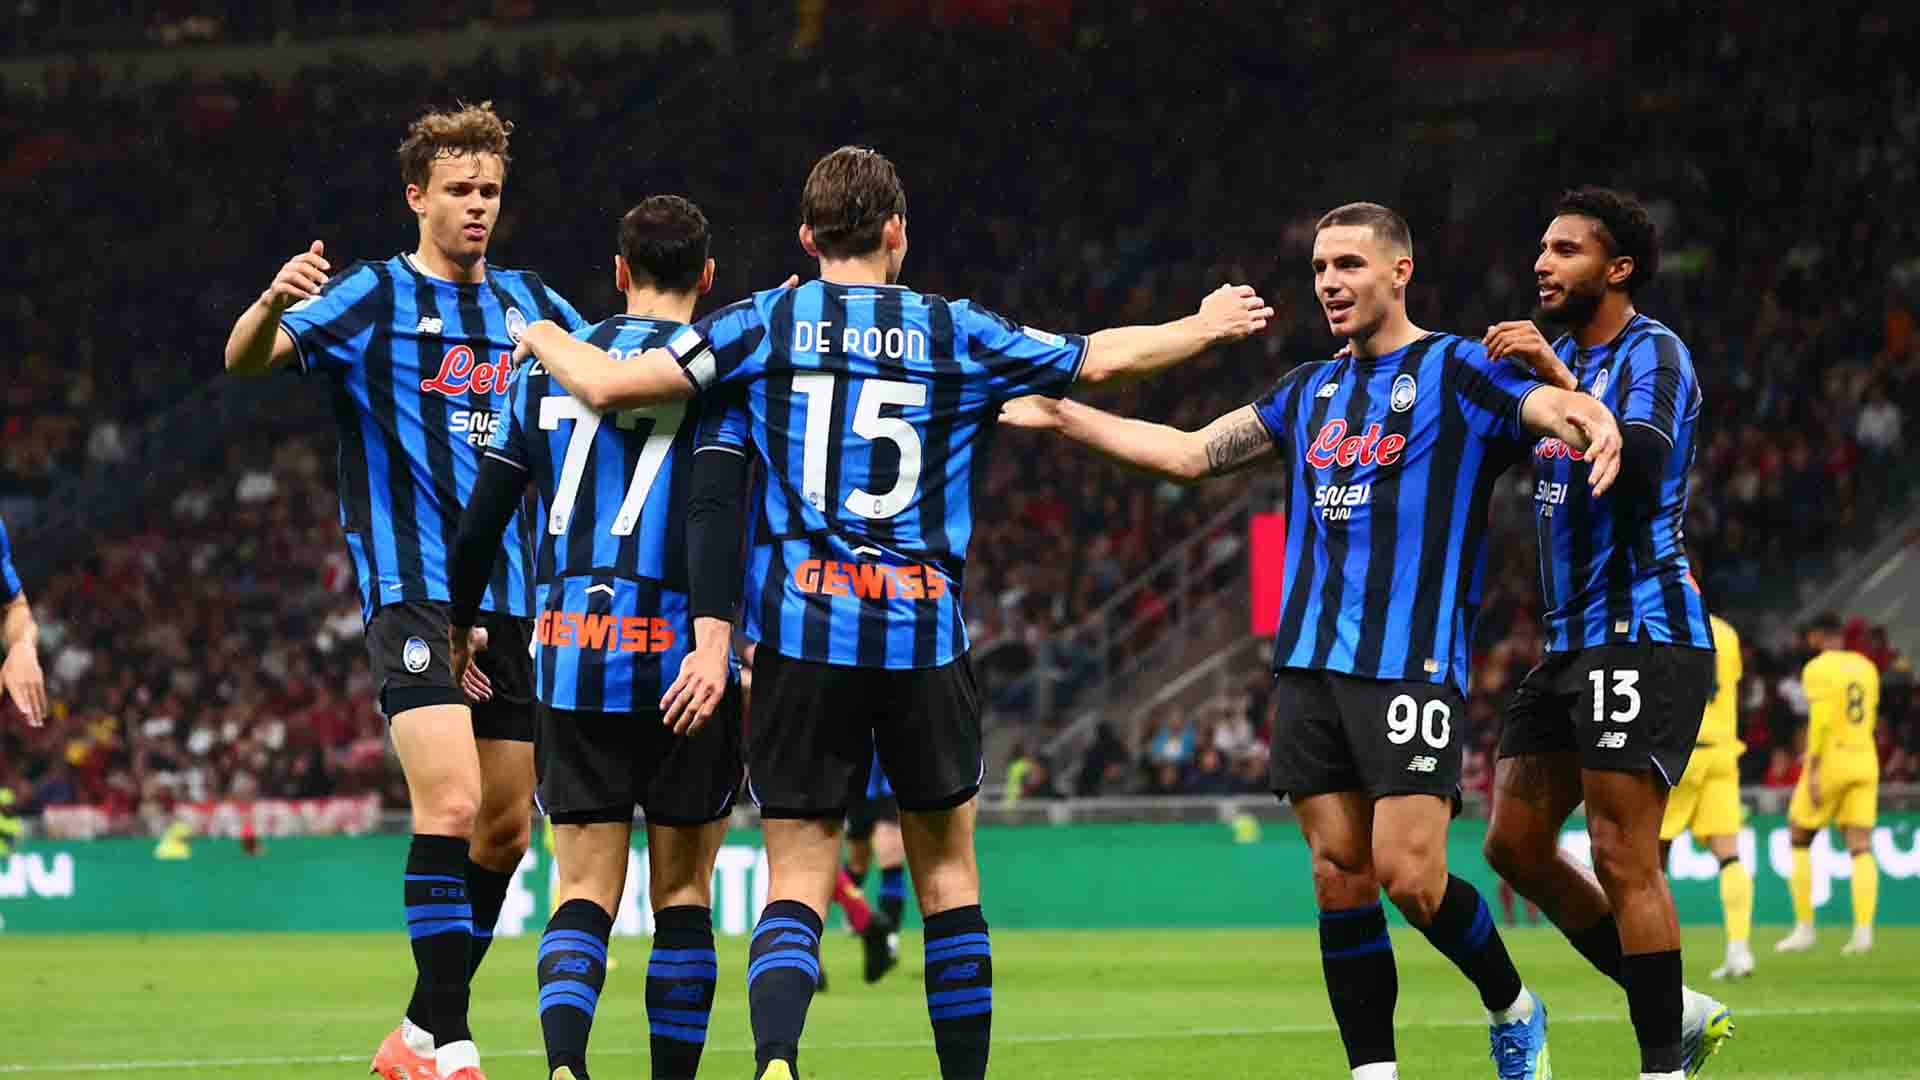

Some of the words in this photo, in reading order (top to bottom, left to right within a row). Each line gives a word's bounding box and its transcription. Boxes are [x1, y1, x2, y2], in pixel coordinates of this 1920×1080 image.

[794, 321, 832, 353] DE
[842, 327, 925, 361] ROON
[421, 344, 511, 395] Let
[538, 396, 686, 536] 77
[791, 370, 927, 520] 15
[1306, 418, 1406, 470] Lete
[1322, 507, 1352, 521] FUN
[1387, 694, 1451, 749] 90
[1589, 669, 1641, 723] 13
[1845, 682, 1866, 725] 8
